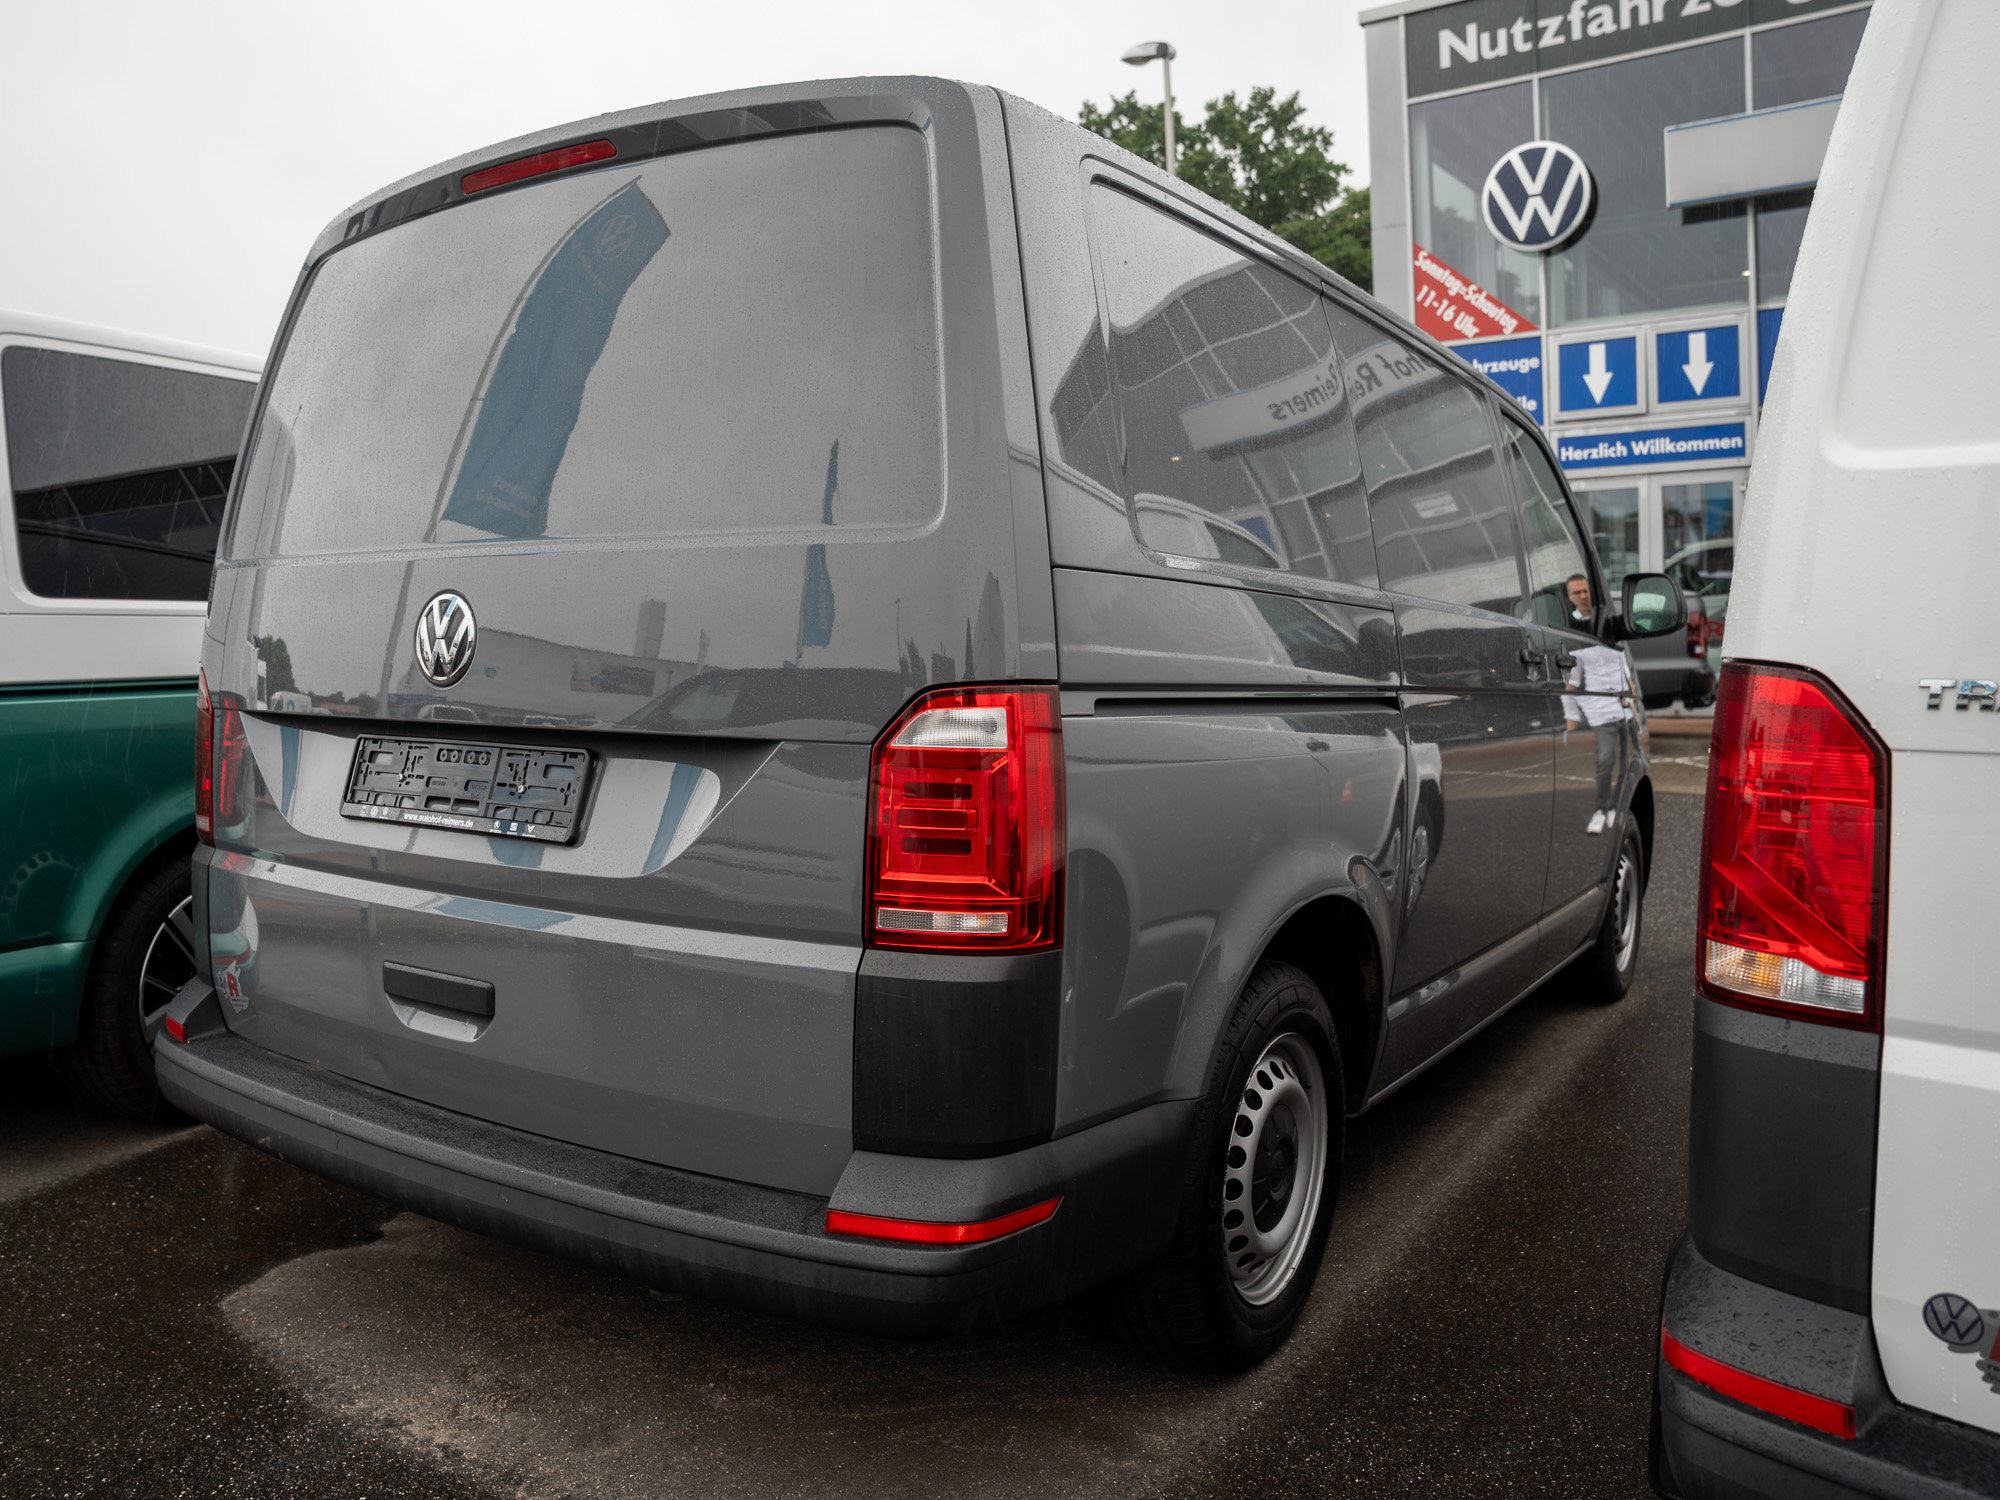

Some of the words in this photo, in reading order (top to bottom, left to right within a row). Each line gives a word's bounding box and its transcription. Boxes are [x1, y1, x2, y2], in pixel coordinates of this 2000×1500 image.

[1438, 0, 1813, 69] Nutzfahrz
[1416, 285, 1457, 322] 11-16
[1453, 311, 1480, 338] Uhr
[1560, 441, 1627, 461] Herzlich
[1630, 436, 1743, 456] Willkommen
[1919, 679, 2000, 711] TR
[403, 812, 474, 828] www.autohof-reimers.de
